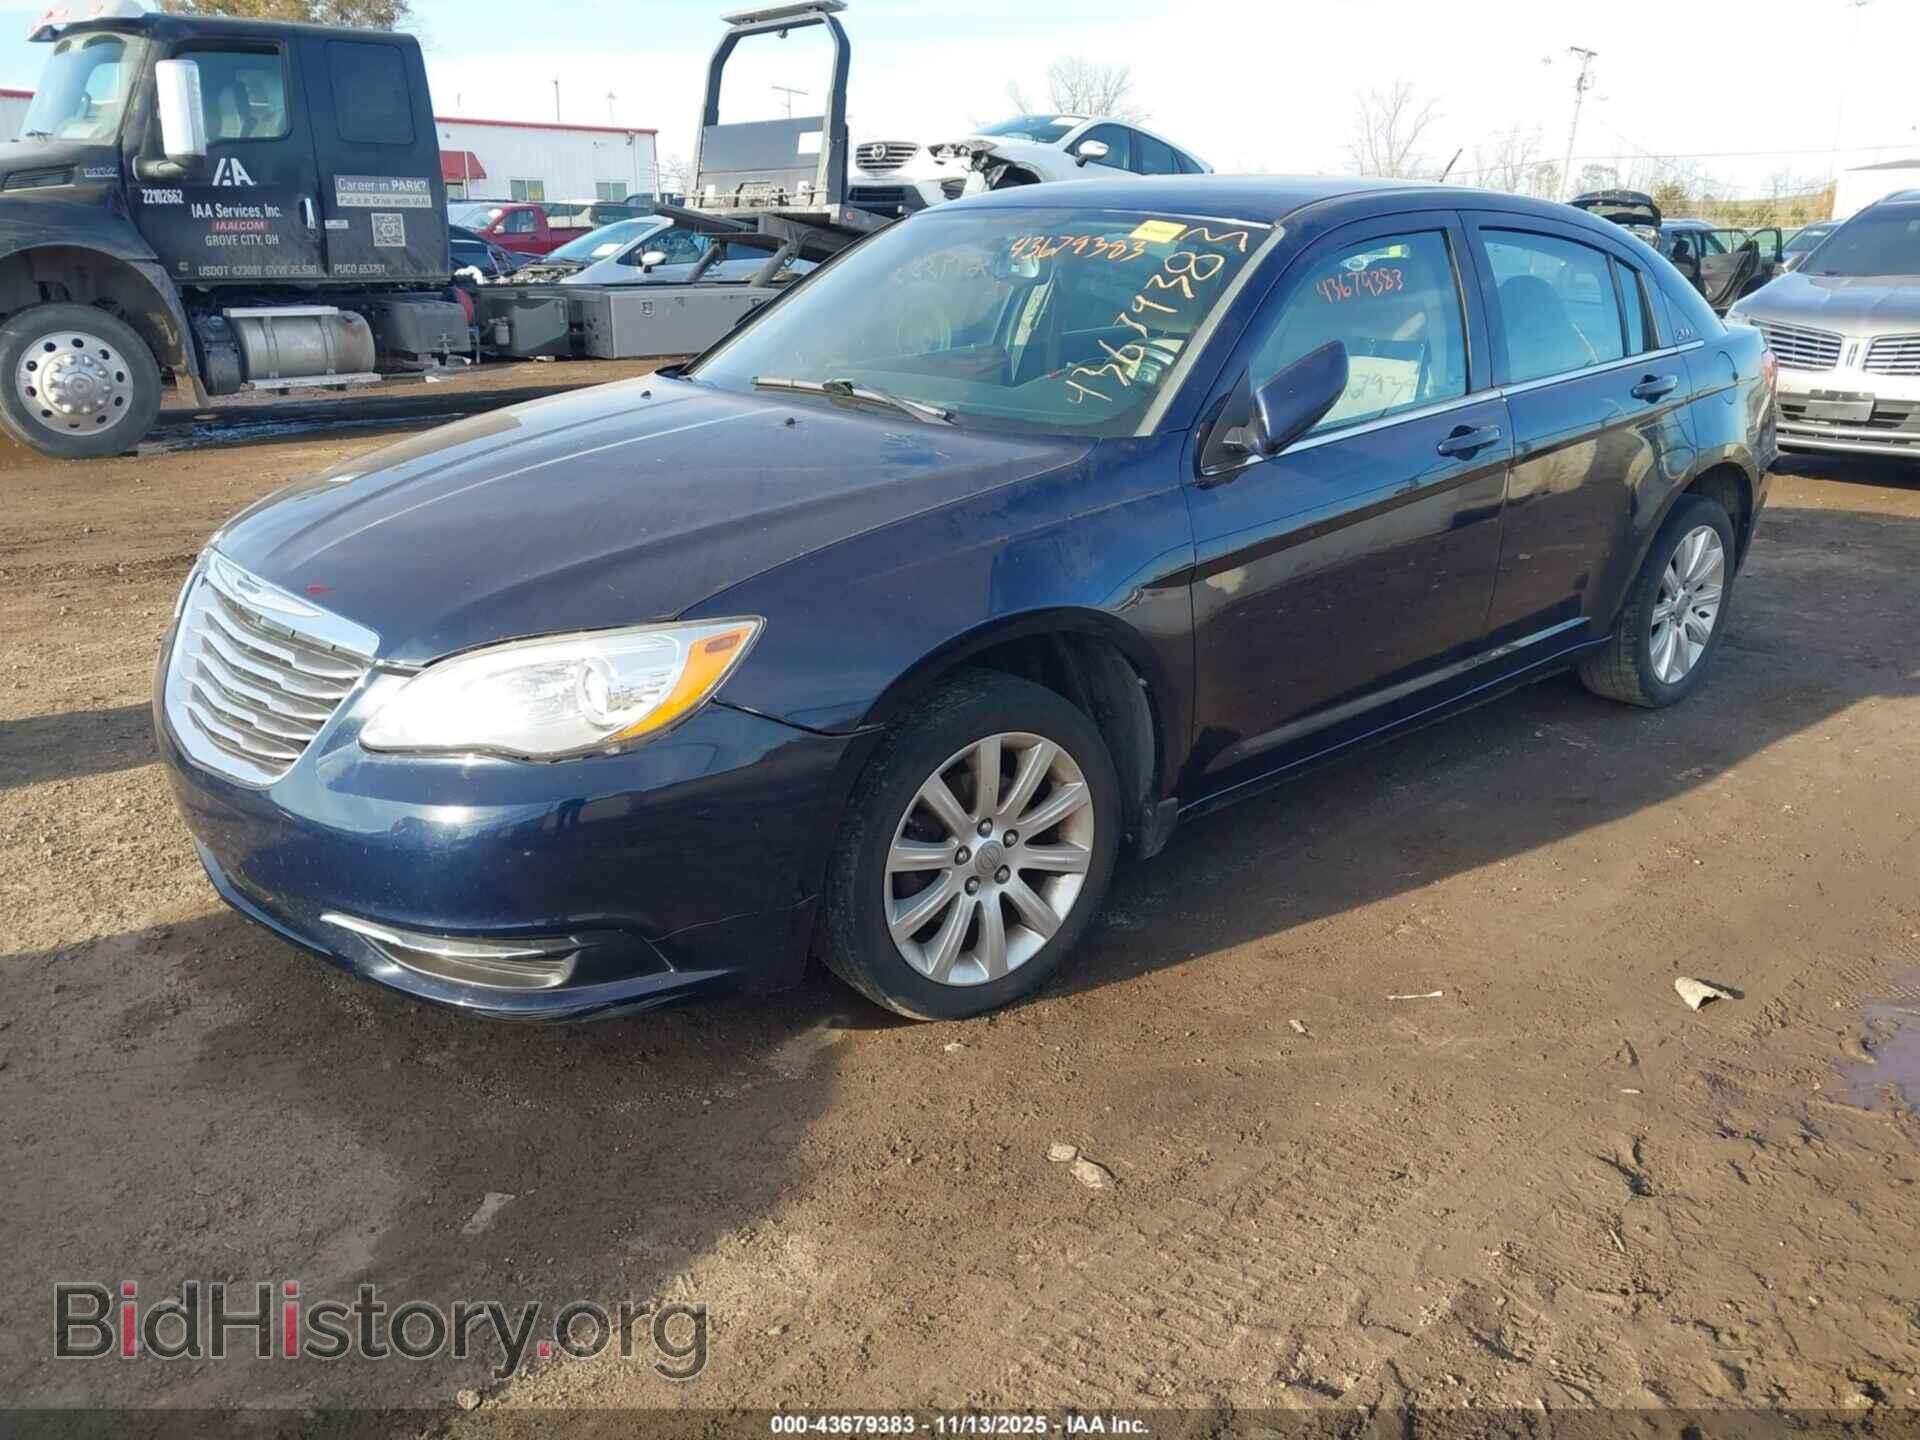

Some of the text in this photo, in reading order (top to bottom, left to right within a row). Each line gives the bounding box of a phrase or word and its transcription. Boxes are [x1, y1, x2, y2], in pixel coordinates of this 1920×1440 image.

[338, 177, 427, 193] Career in PARK?
[191, 203, 282, 219] IAA Services, Inc.
[204, 235, 239, 246] GROVE
[265, 234, 280, 245] OH
[1010, 234, 1147, 263] 43679383
[198, 265, 229, 276] USDOT
[334, 263, 357, 274] PUCO
[1316, 267, 1404, 304] 43679383
